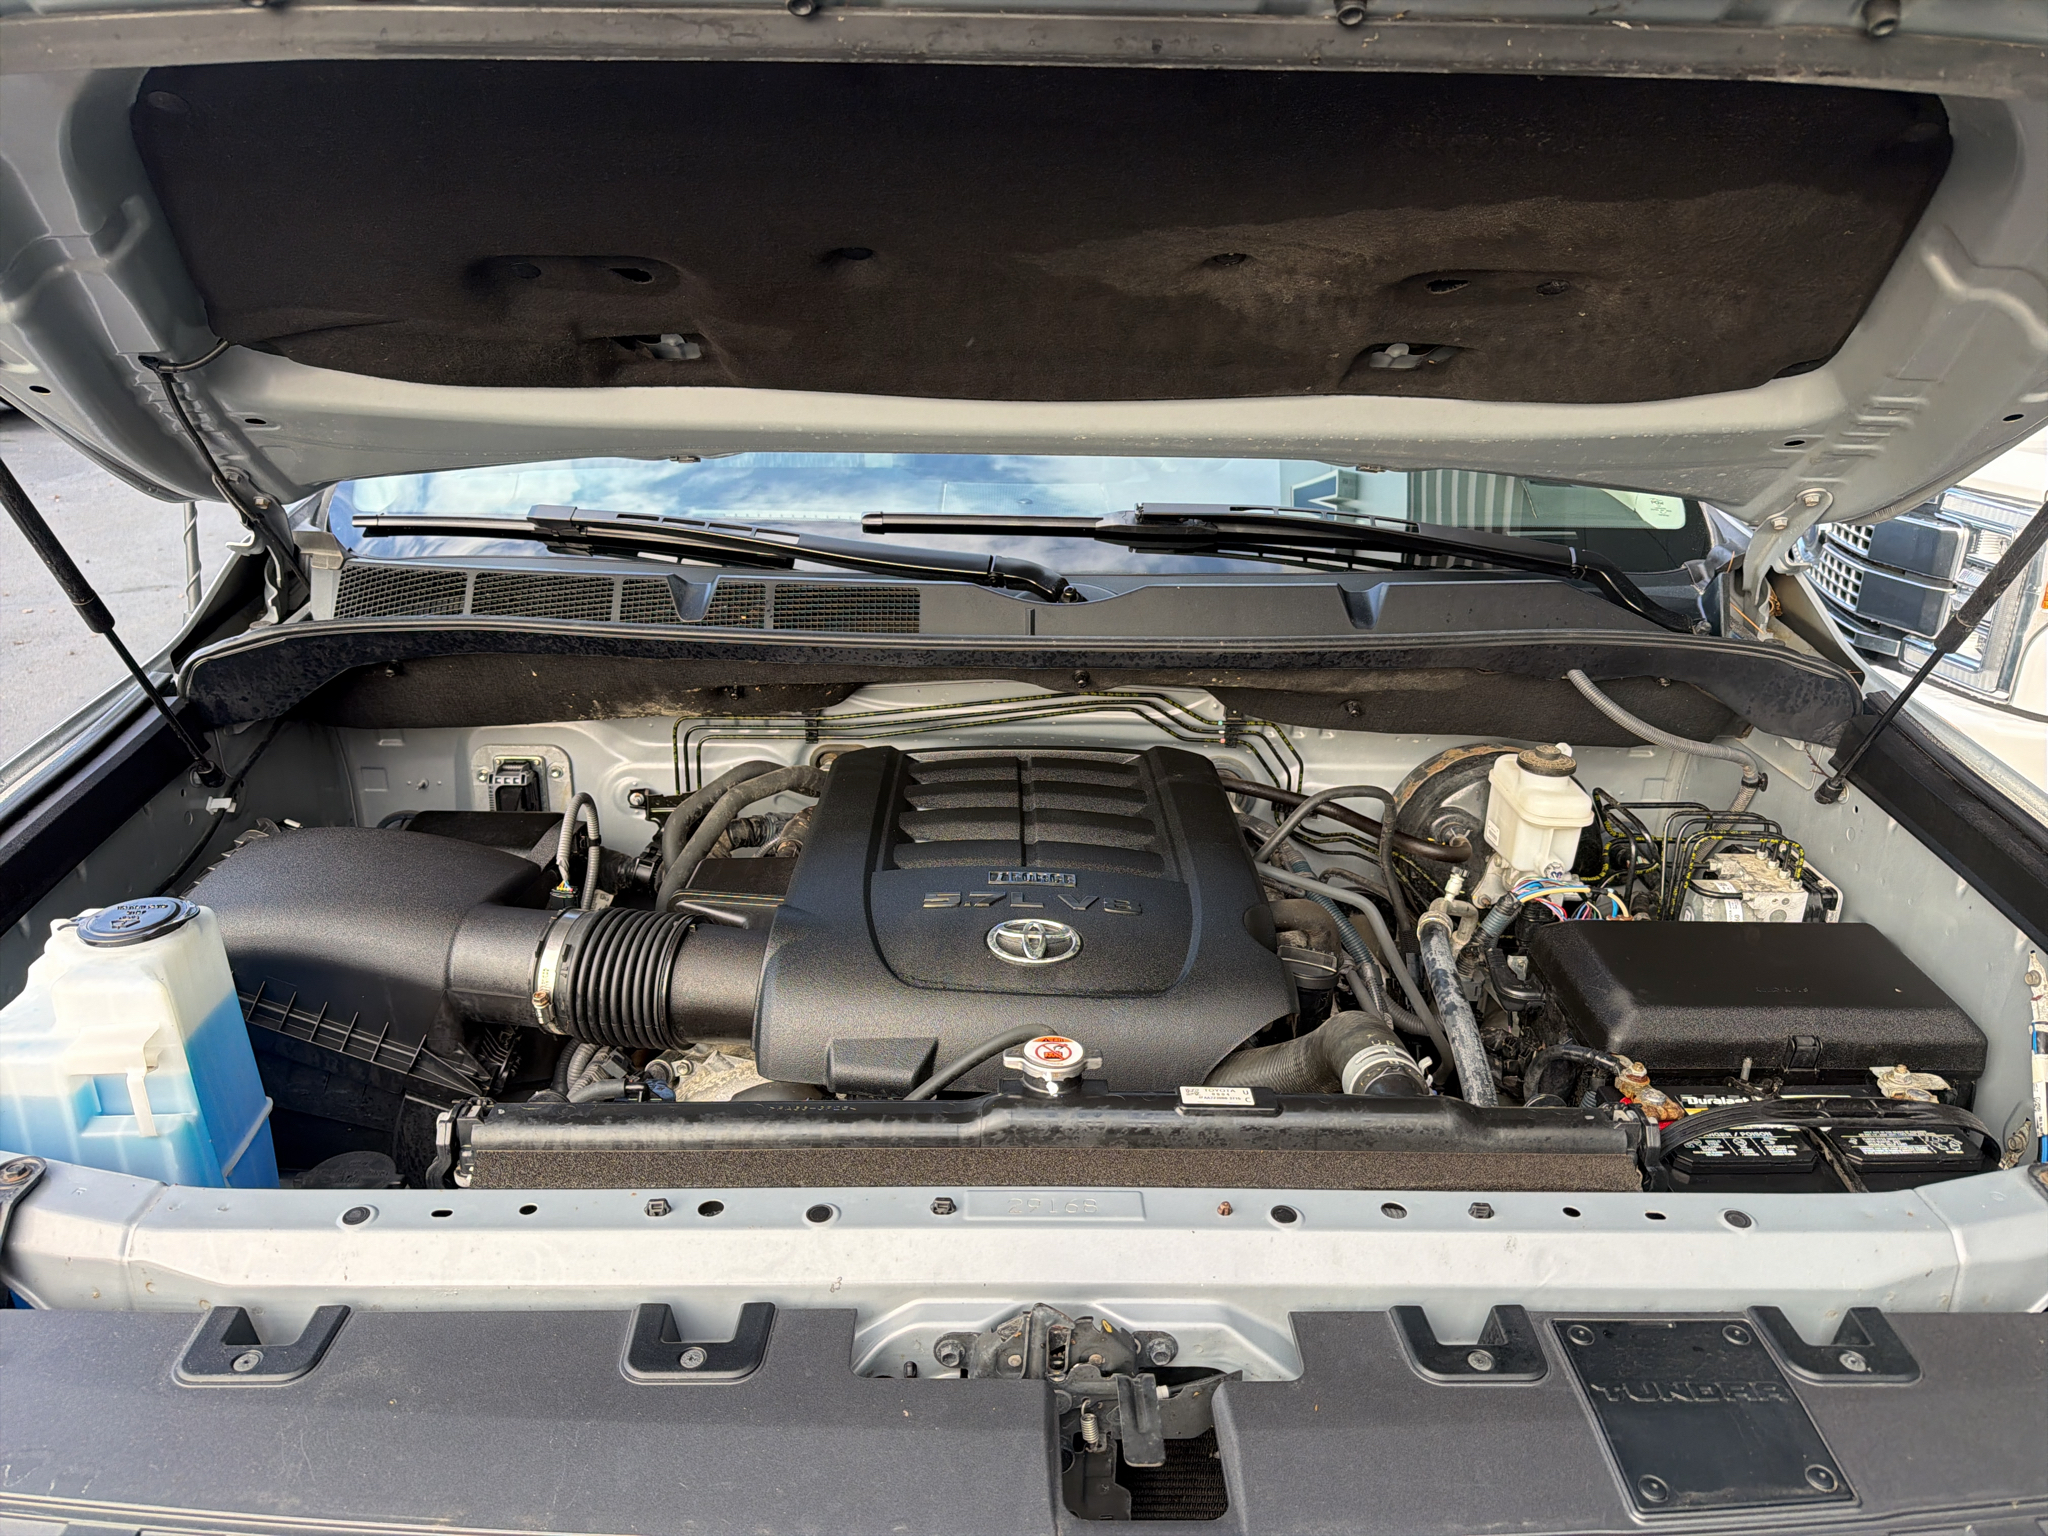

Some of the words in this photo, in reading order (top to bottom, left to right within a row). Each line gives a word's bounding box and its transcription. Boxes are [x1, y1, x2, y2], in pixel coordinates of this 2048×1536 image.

[922, 891, 1044, 908] 5.7L
[1057, 893, 1143, 915] V8
[1007, 1198, 1099, 1215] 29168
[1590, 1378, 1791, 1403] TUNDRA
